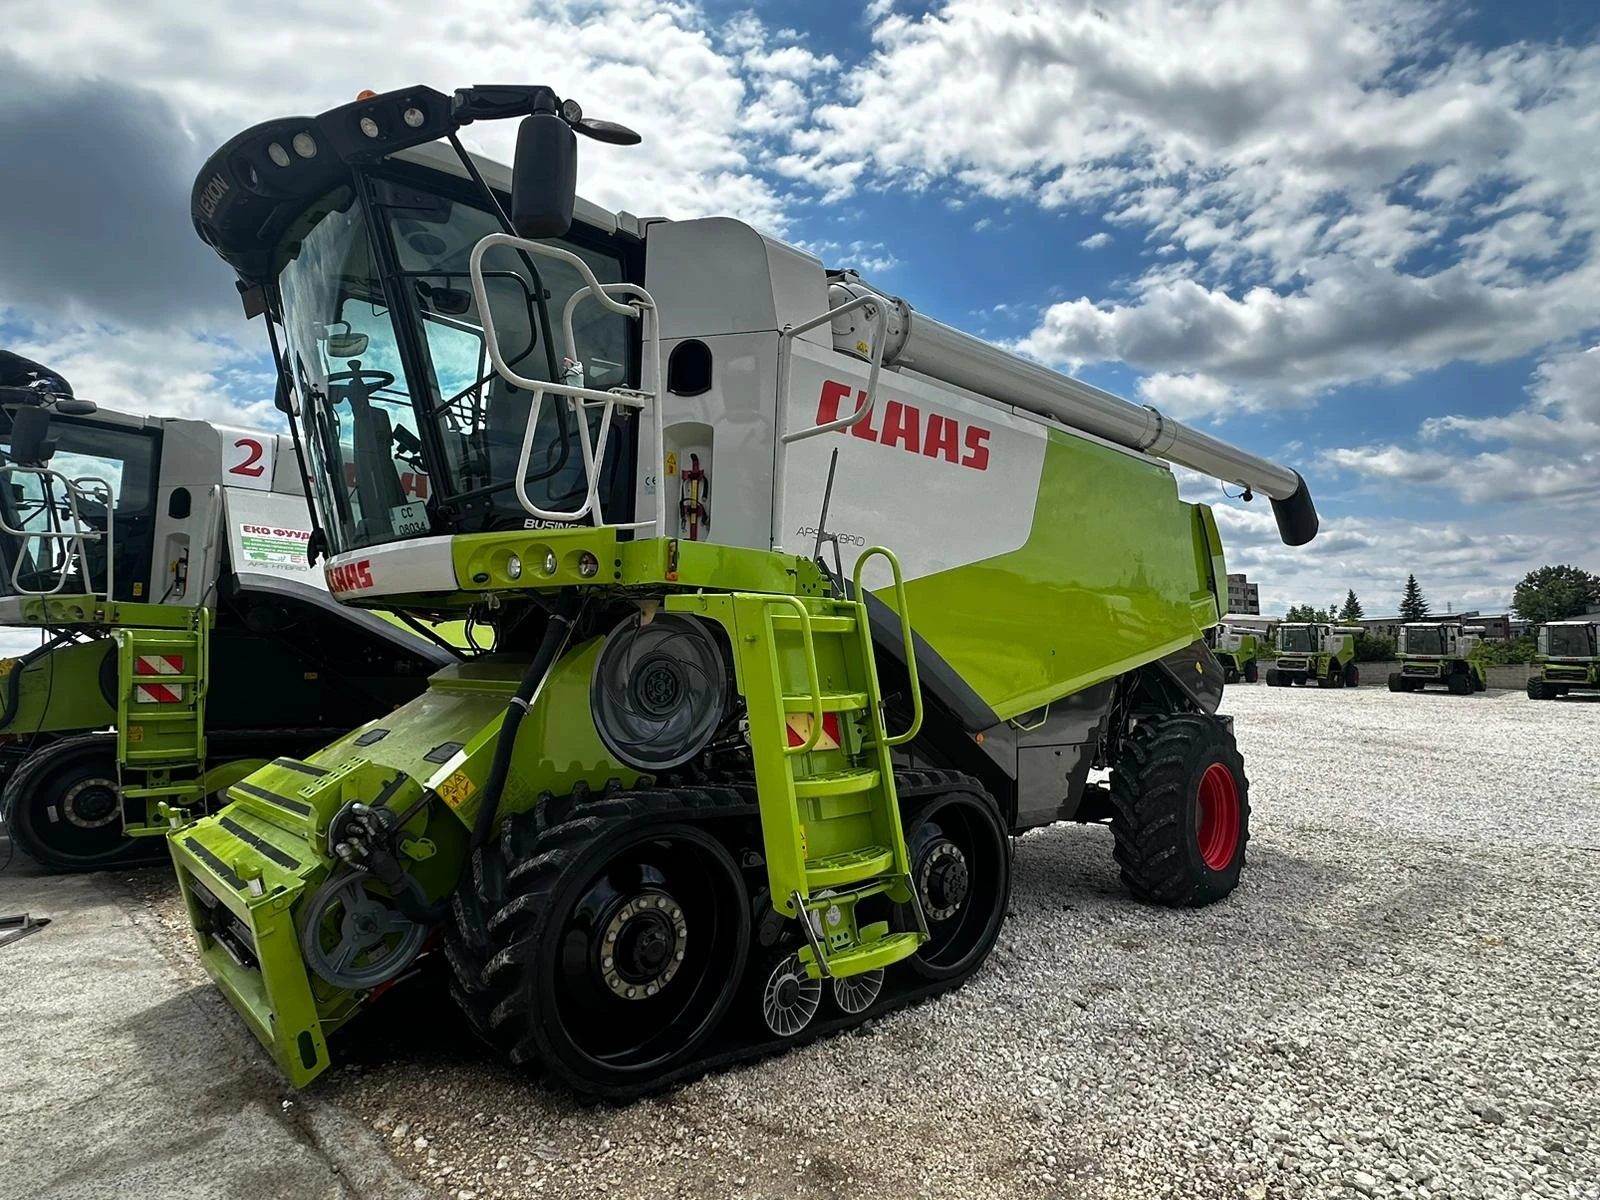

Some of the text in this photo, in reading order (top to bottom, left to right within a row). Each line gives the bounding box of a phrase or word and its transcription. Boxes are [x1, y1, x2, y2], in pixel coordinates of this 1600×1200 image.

[815, 379, 990, 471] CLAAS
[229, 438, 264, 477] 2
[400, 506, 414, 519] CC
[242, 525, 271, 535] ЕКО
[523, 518, 592, 530] BUSIN
